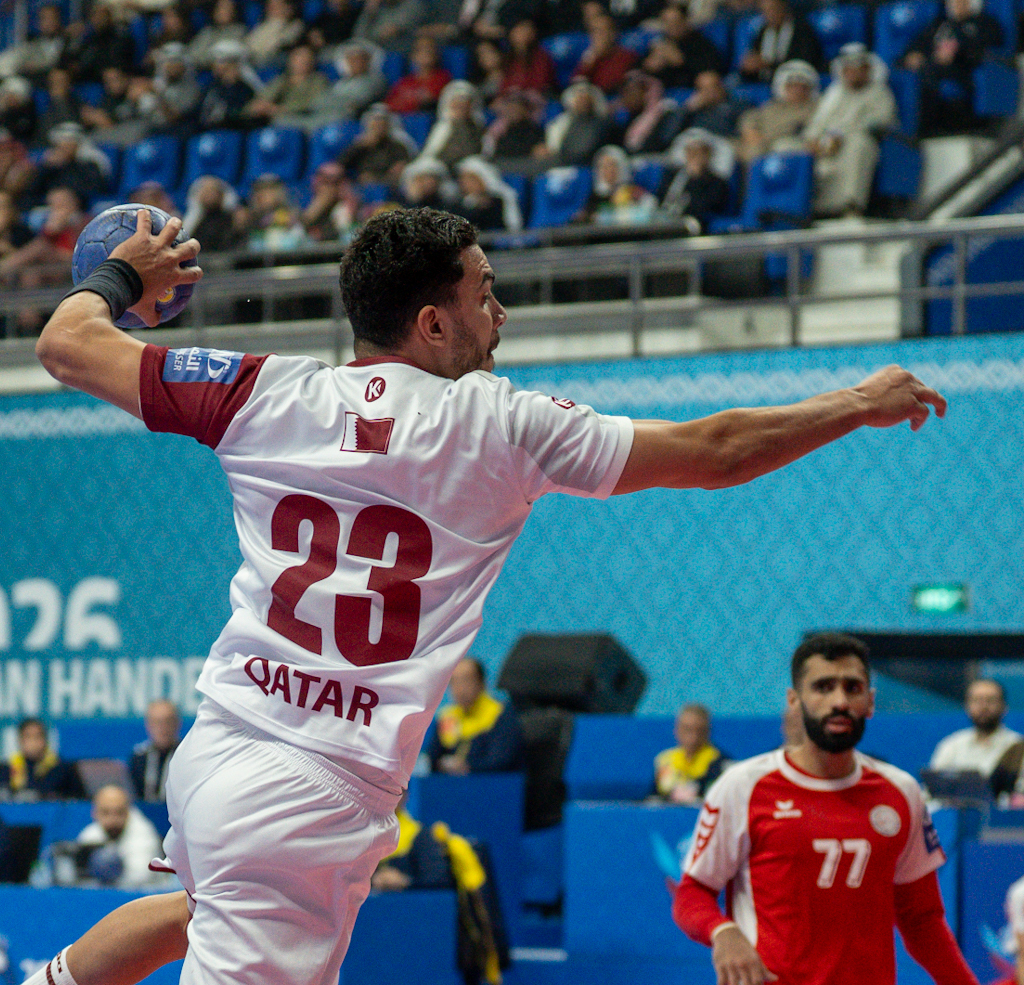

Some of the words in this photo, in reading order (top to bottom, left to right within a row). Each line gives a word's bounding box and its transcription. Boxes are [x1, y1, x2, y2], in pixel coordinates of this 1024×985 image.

[267, 494, 433, 667] 23
[244, 657, 380, 727] QATAR
[812, 838, 872, 889] 77
